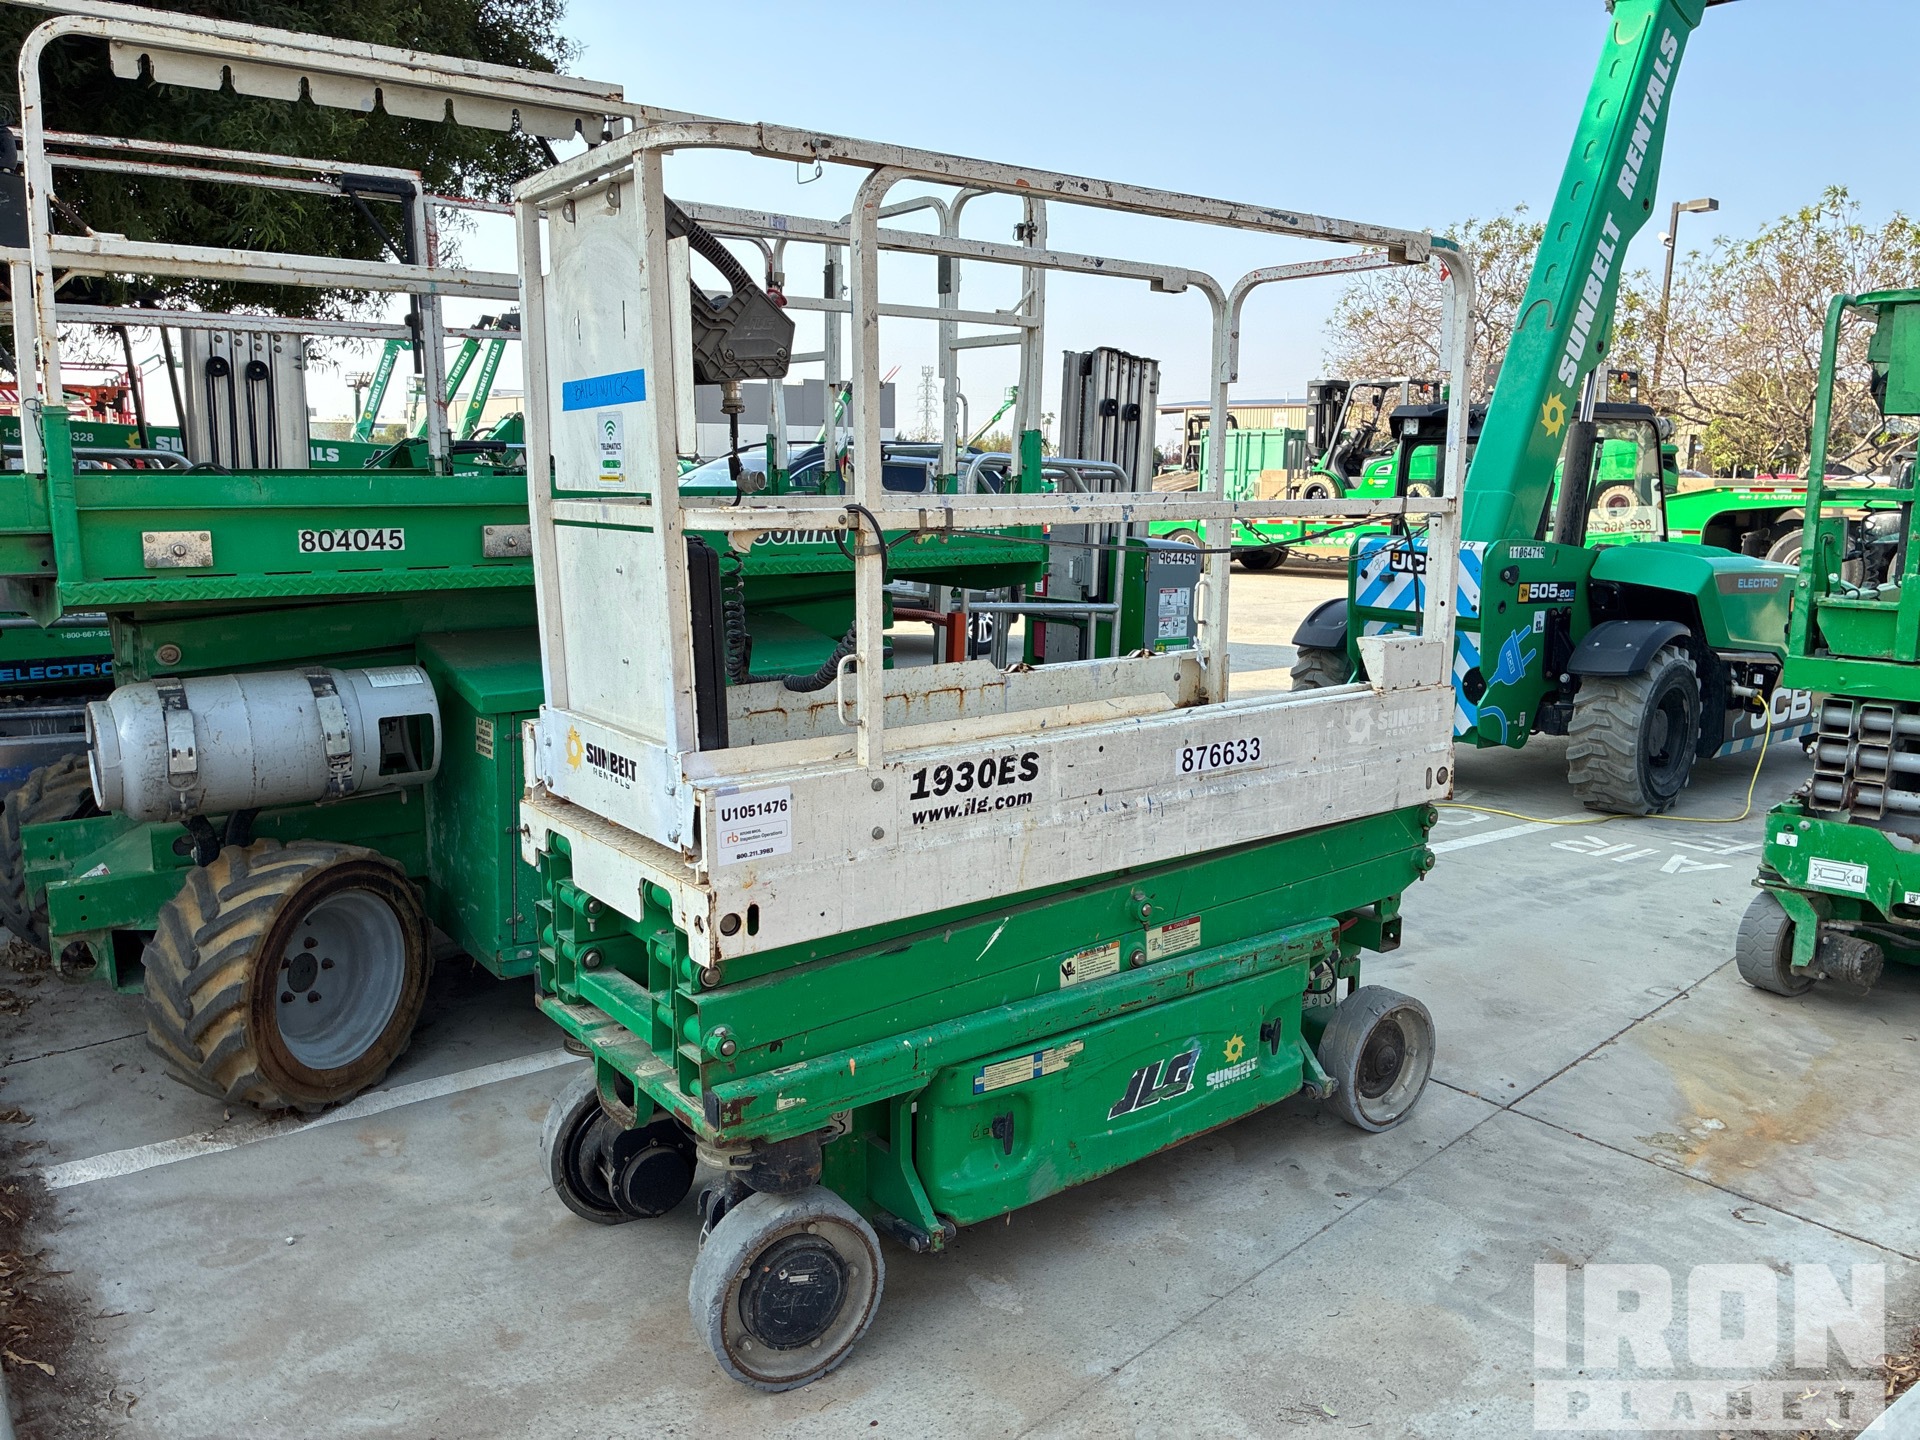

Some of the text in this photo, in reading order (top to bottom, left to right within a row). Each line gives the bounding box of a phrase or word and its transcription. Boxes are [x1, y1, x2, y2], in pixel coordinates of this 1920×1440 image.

[1557, 27, 1679, 388] SUNBELT RENTALS
[300, 529, 404, 552] 804045
[1158, 552, 1198, 566] 964459
[1391, 552, 1427, 572] JC
[1737, 577, 1779, 589] ELECTRIC
[586, 742, 637, 783] SUNBELT
[1181, 737, 1261, 773] 876633
[592, 766, 630, 790] RENTALS
[909, 751, 1040, 801] 1930ES
[721, 799, 788, 822] U1051476
[1206, 1056, 1259, 1087] SUNBELT
[1213, 1072, 1251, 1090] RENTALS
[1107, 1048, 1201, 1121] JLG
